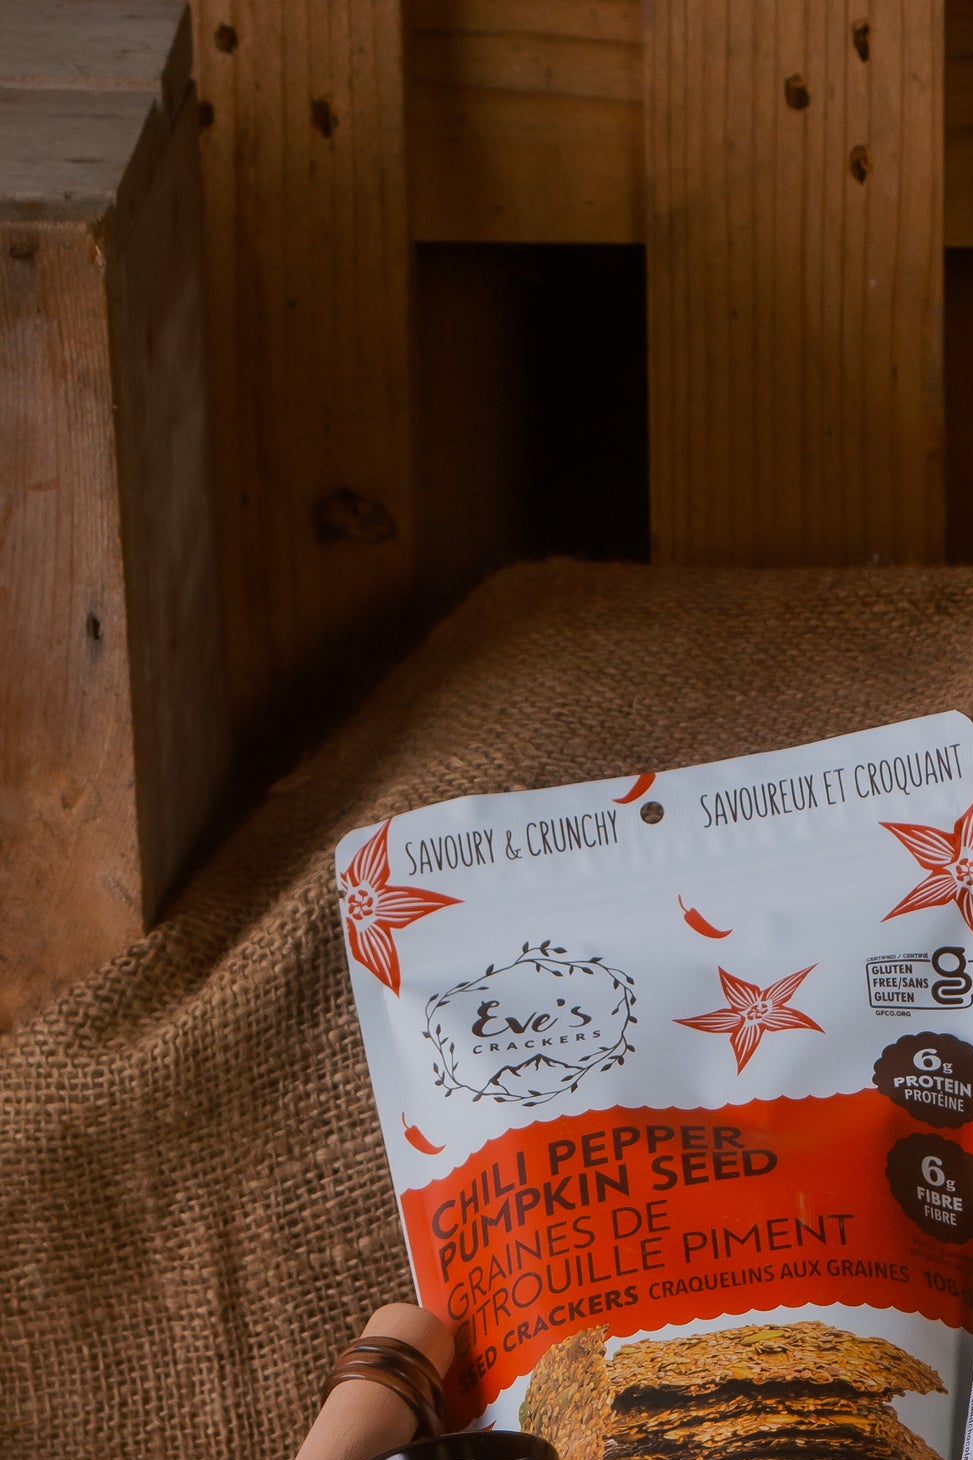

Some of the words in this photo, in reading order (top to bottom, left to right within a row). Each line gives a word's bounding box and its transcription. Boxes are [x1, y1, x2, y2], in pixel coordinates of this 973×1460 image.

[700, 774, 818, 828] SAVOUREUX
[823, 767, 846, 806] ET
[854, 743, 963, 799] CROQUANT
[405, 828, 495, 876] SAVOURY
[505, 829, 523, 860] &
[526, 809, 618, 857] CRUNCHY
[872, 964, 913, 975] GLUTEN
[873, 977, 929, 989] FREE/SANS
[874, 992, 915, 1002] GLUTEN
[471, 998, 592, 1038] Eve's
[472, 1030, 601, 1055] CRACKERS
[893, 1075, 972, 1098] PROTEIN
[904, 1088, 965, 1112] PROTÉINE
[432, 1151, 528, 1240] CHILI
[548, 1125, 745, 1175] PEPPER
[916, 1186, 963, 1212] FIBRE
[438, 1163, 630, 1282] PUMPKIN
[652, 1149, 777, 1191] SEED
[924, 1205, 957, 1226] FIBRE
[447, 1215, 595, 1321] GRAINES
[612, 1199, 671, 1240] DE
[454, 1236, 665, 1357] CITROUILLE
[683, 1213, 854, 1264] PIMENT
[502, 1285, 639, 1352] CRACKERS
[649, 1264, 775, 1301] CRAQUELINS
[780, 1260, 820, 1279] AUX
[826, 1259, 910, 1284] GRAINES
